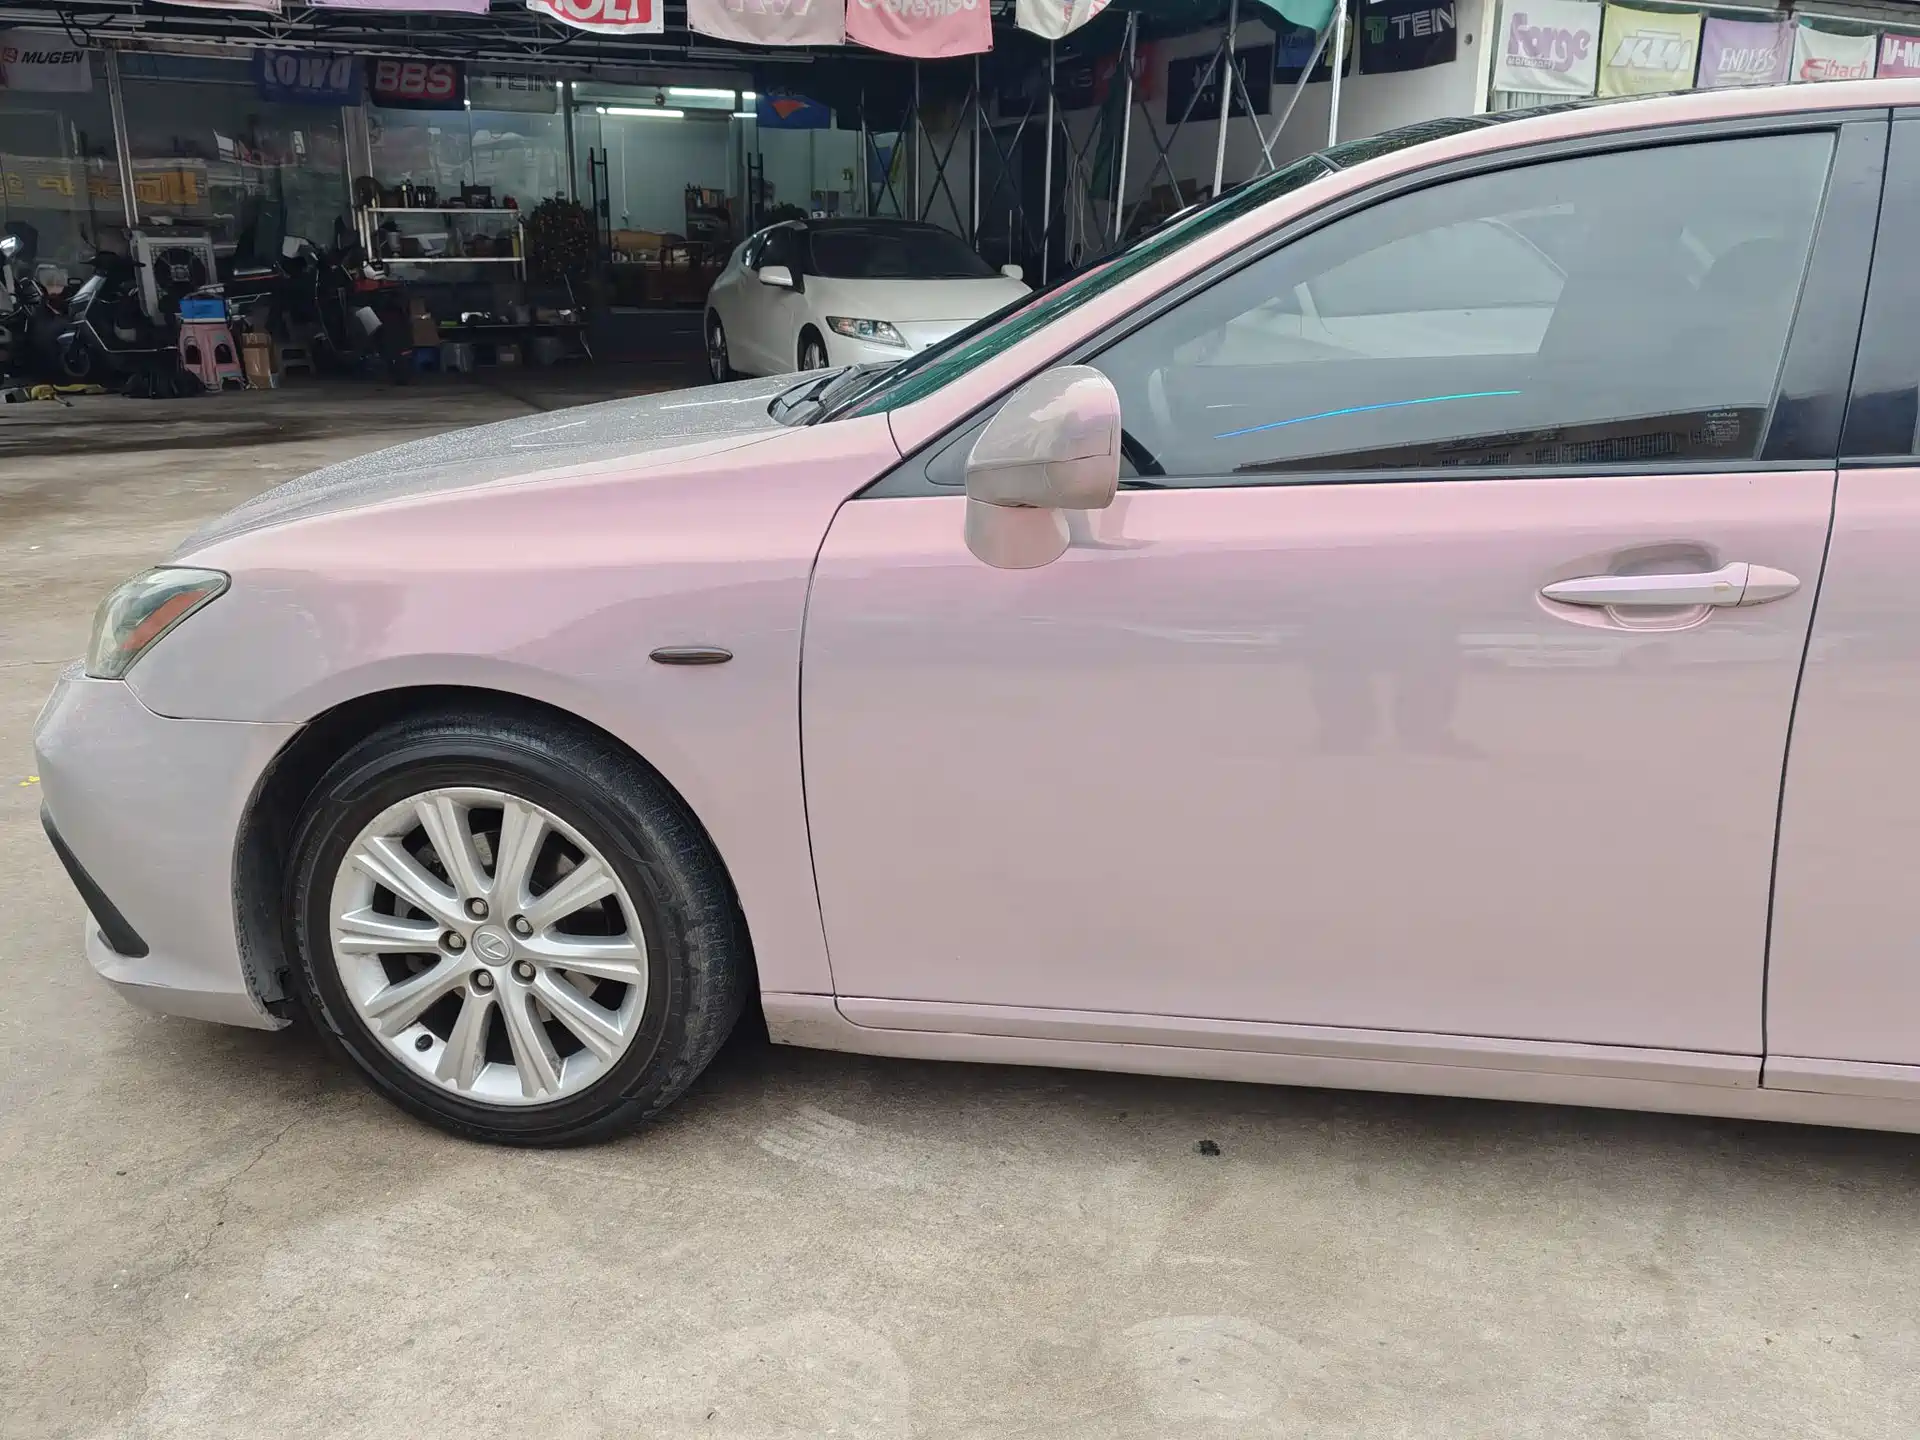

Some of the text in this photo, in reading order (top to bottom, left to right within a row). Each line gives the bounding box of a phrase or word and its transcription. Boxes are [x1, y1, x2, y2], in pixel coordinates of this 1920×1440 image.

[1391, 2, 1456, 39] TEIN
[21, 51, 84, 64] MUGEN
[1717, 48, 1778, 72] ENDLESS
[1800, 58, 1868, 80] Eibach
[375, 59, 453, 94] BBS
